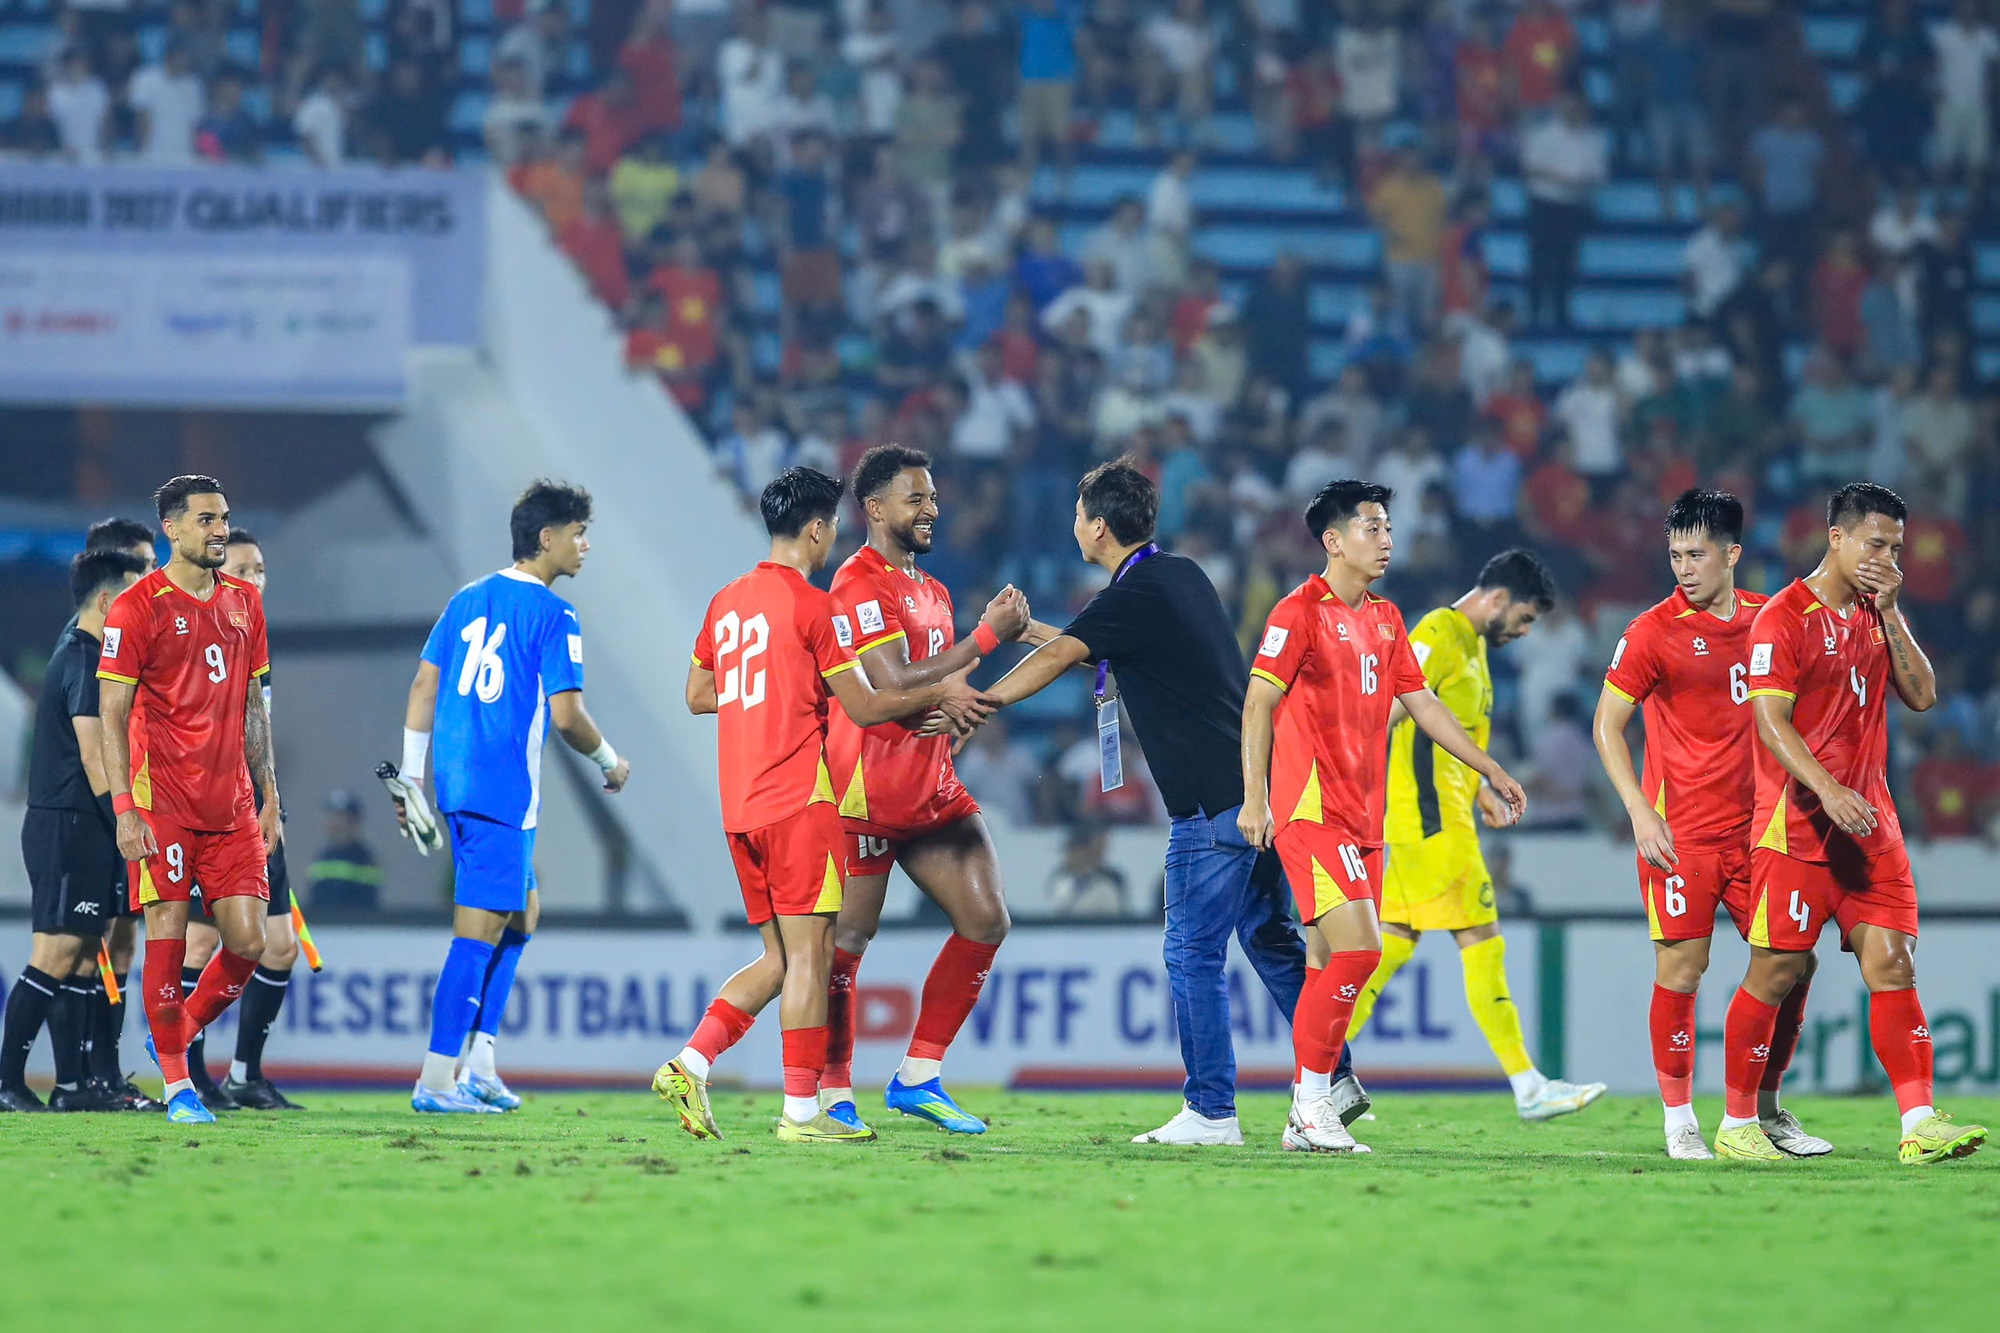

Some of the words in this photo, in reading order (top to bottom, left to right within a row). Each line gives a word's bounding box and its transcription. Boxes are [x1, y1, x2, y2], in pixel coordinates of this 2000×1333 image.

[204, 643, 227, 684] 9
[457, 616, 507, 703] 16
[714, 610, 769, 711] 22
[1360, 653, 1379, 695] 16
[1729, 662, 1748, 706] 6
[1850, 665, 1866, 707] 4
[166, 842, 184, 883] 9
[1337, 843, 1368, 883] 16
[73, 901, 100, 916] AFC
[1665, 874, 1687, 917] 6
[1788, 889, 1810, 932] 4
